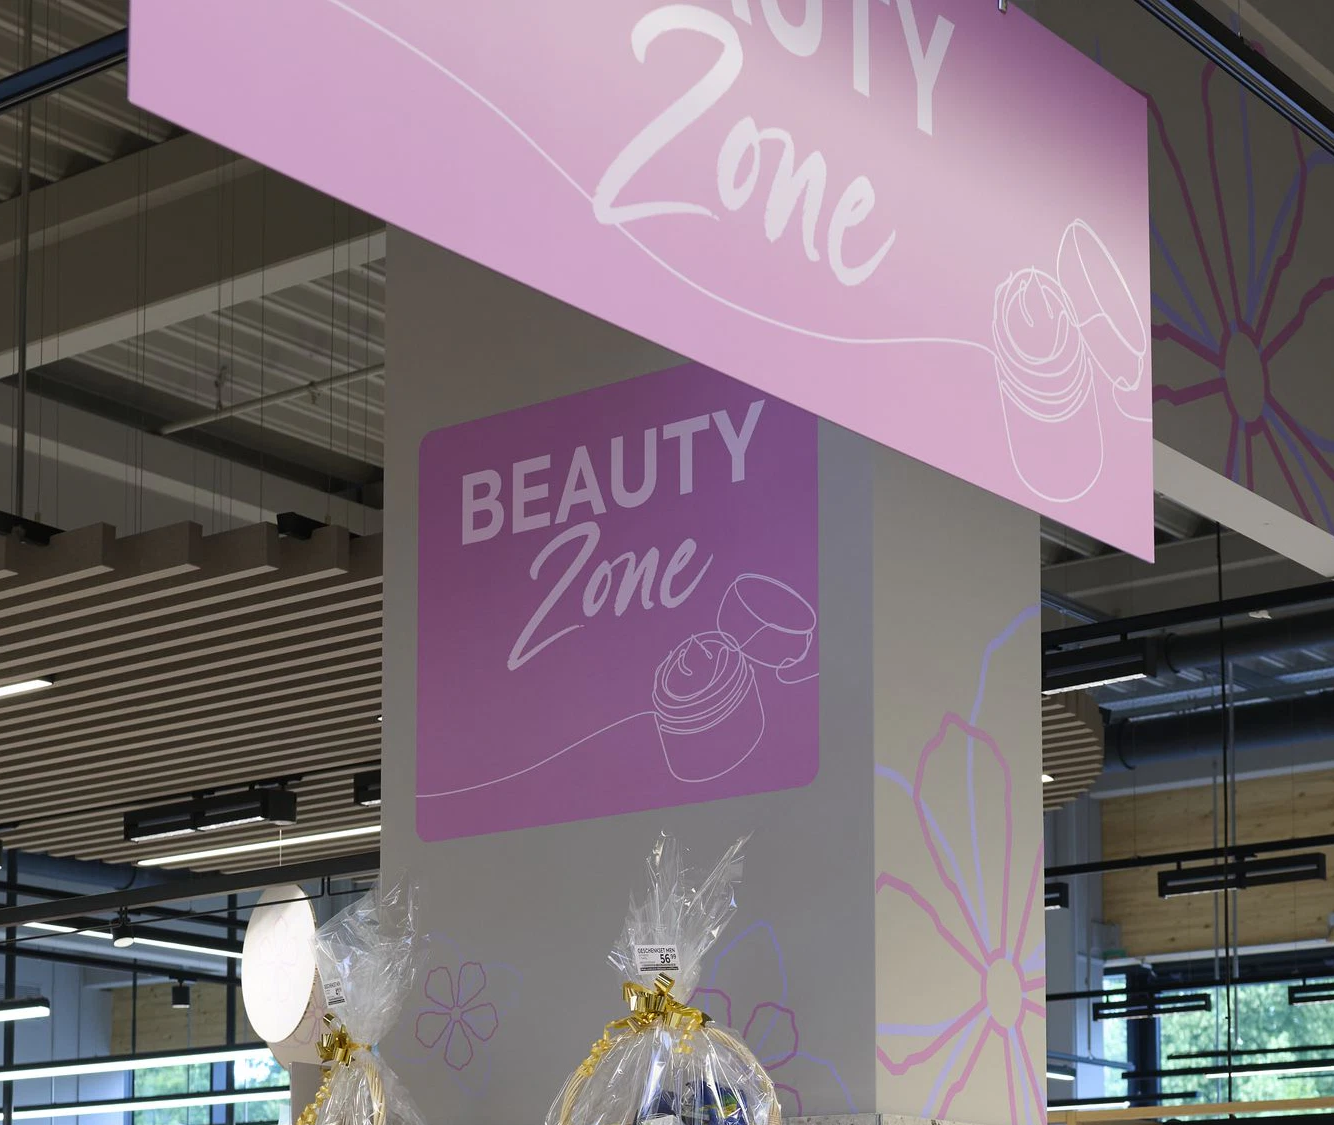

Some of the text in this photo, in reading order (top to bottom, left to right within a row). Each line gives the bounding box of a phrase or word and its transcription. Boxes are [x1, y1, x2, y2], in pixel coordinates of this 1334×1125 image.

[592, 4, 895, 286] Zone
[461, 400, 765, 545] BEAUTY
[507, 523, 714, 671] Zone
